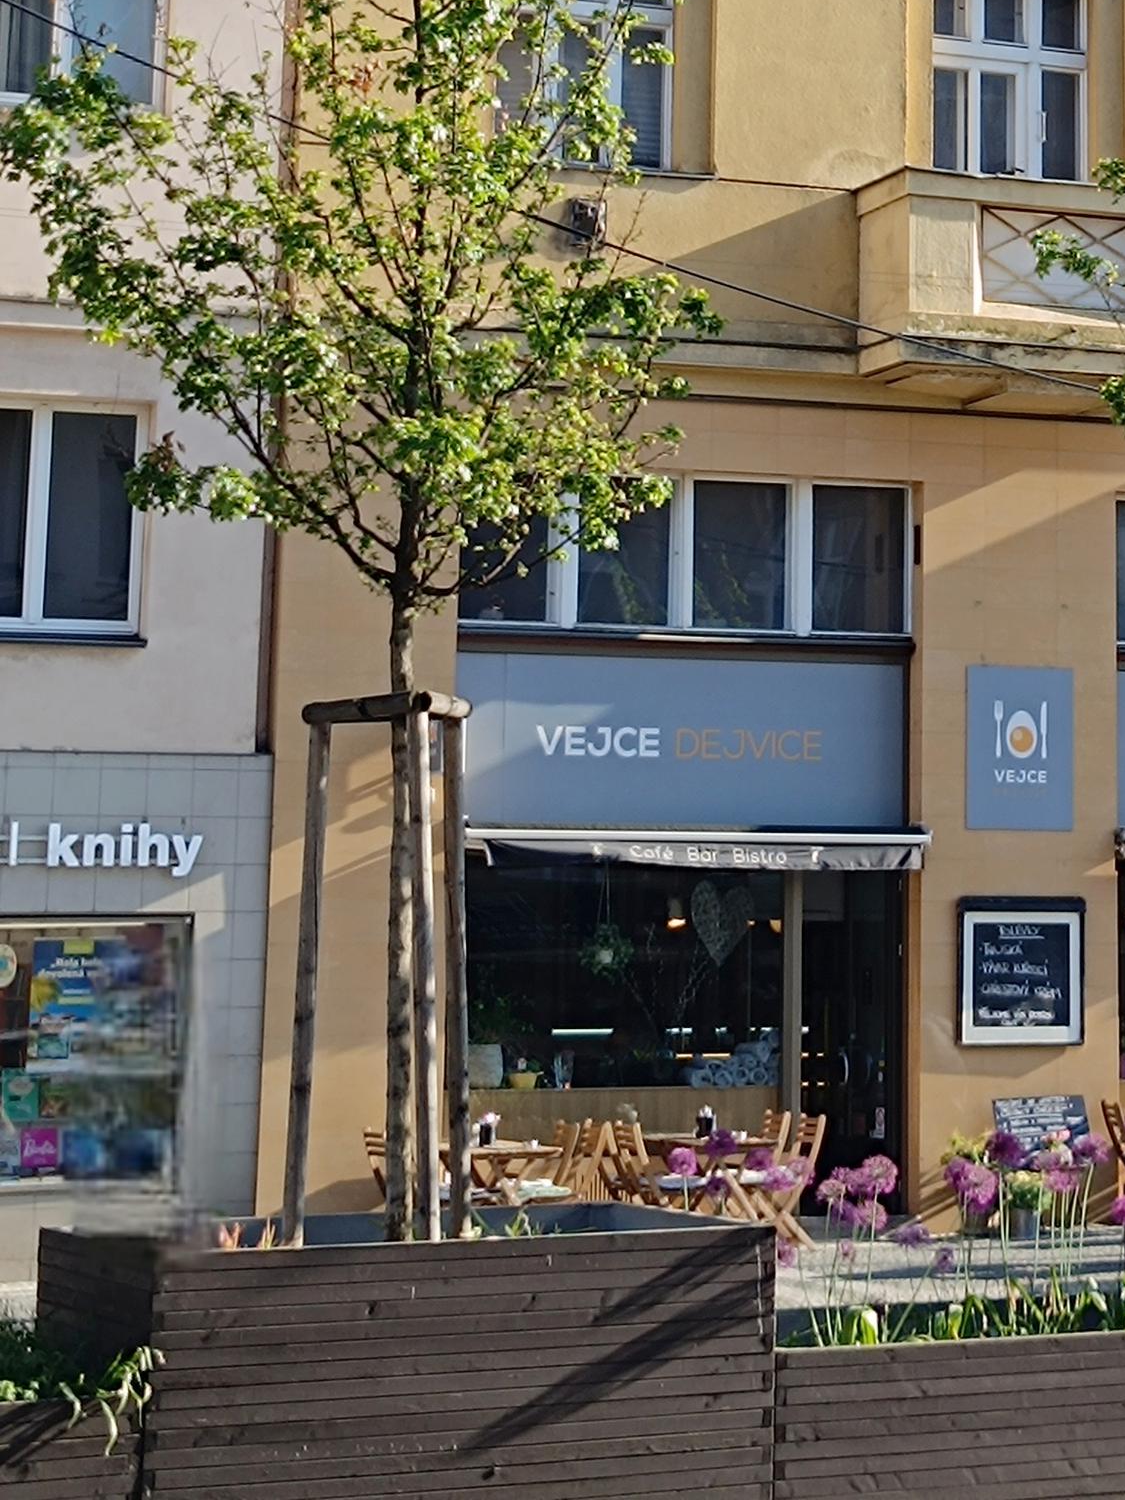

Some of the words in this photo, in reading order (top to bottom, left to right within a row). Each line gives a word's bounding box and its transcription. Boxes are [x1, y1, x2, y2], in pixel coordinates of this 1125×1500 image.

[535, 723, 661, 758] VEJCE
[674, 728, 822, 761] DEJVICE
[993, 769, 1048, 784] VEJCE
[46, 822, 204, 877] knihy
[629, 844, 674, 861] Café
[686, 846, 719, 862] Bar
[732, 847, 788, 864] Bistro
